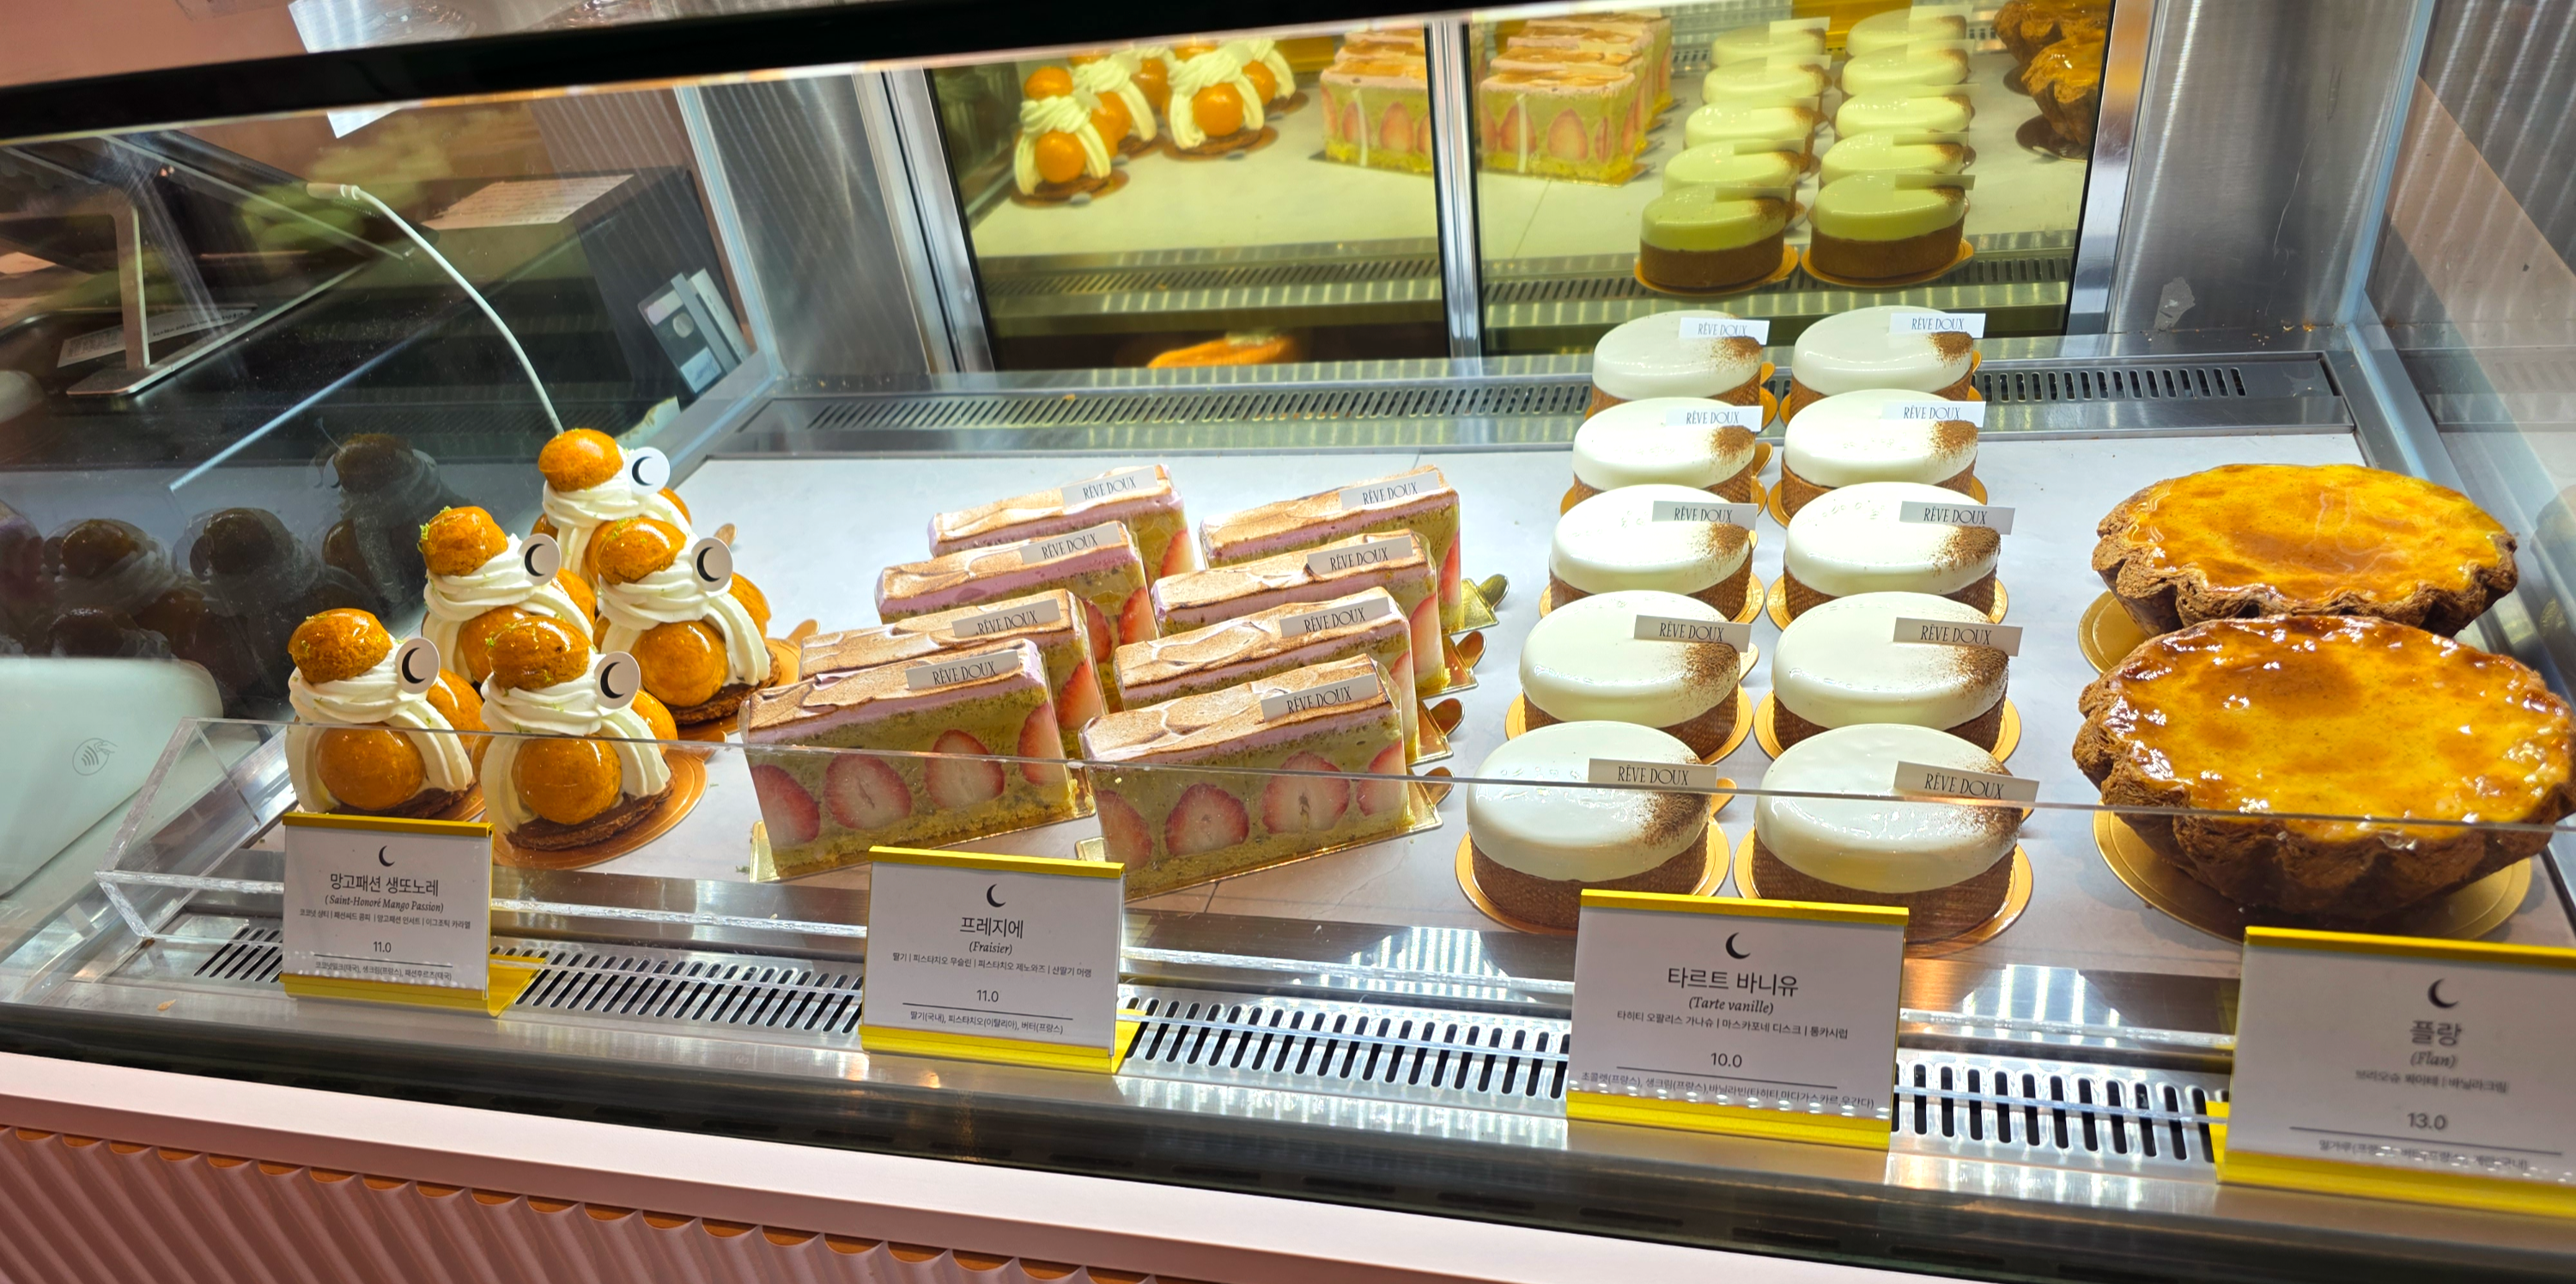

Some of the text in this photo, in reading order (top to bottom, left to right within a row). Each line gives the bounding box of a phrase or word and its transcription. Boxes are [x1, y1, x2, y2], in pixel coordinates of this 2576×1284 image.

[1698, 322, 1747, 337] RÊVE DOUX
[1911, 317, 1965, 331] RÊVE DOUX
[1686, 410, 1740, 425] RÊVE DOUX
[1903, 405, 1961, 421] RÊVE DOUX
[1083, 476, 1136, 501] RÊVE DOUX
[1362, 482, 1418, 506] RÊVE DOUX
[1674, 506, 1734, 523] RÊVE DOUX
[1923, 507, 1988, 525] RÊVE DOUX
[1041, 532, 1098, 560] RÊVE DOUX
[1329, 547, 1389, 571] RÊVE DOUX
[977, 610, 1038, 636] RÊVE DOUX
[1303, 607, 1366, 634] RÊVE DOUX
[1659, 621, 1724, 642] RÊVE DOUX
[1920, 624, 1992, 645] RÊVE DOUX
[932, 660, 997, 686] RÊVE DOUX
[1286, 686, 1352, 715] RÊVE DOUX
[1618, 764, 1690, 786] RÊVE DOUX
[1924, 772, 2004, 800] RÊVE DOUX
[331, 873, 439, 897] 망고패션 생또노레
[382, 898, 410, 912] Mango
[411, 900, 444, 914] Passion)
[378, 914, 401, 924] 망고패션
[403, 916, 421, 925] 인서트
[426, 918, 450, 928] 이그조틱
[959, 916, 1024, 939] 프레지에
[373, 941, 392, 952] 11.0
[969, 941, 1012, 955] (Fraisier)
[893, 952, 1092, 977] 딸기 피스타치오 무슬린 피스타치오 제노와즈 산딸기 머랭
[1668, 966, 1799, 997] 타르트 바니유
[976, 989, 999, 1003] 11.0
[1688, 996, 1774, 1015] (Tarte vanille)
[1021, 1021, 1064, 1035] 버터(프랑스)
[1617, 1010, 1848, 1039] 타히티 오팔리스 가나슈 마스카포네 디스크 통카시럽
[2409, 1020, 2463, 1047] 플랑
[1710, 1052, 1742, 1068] 10.0
[2409, 1051, 2457, 1068] (Flan)
[2408, 1112, 2447, 1130] 13.0
